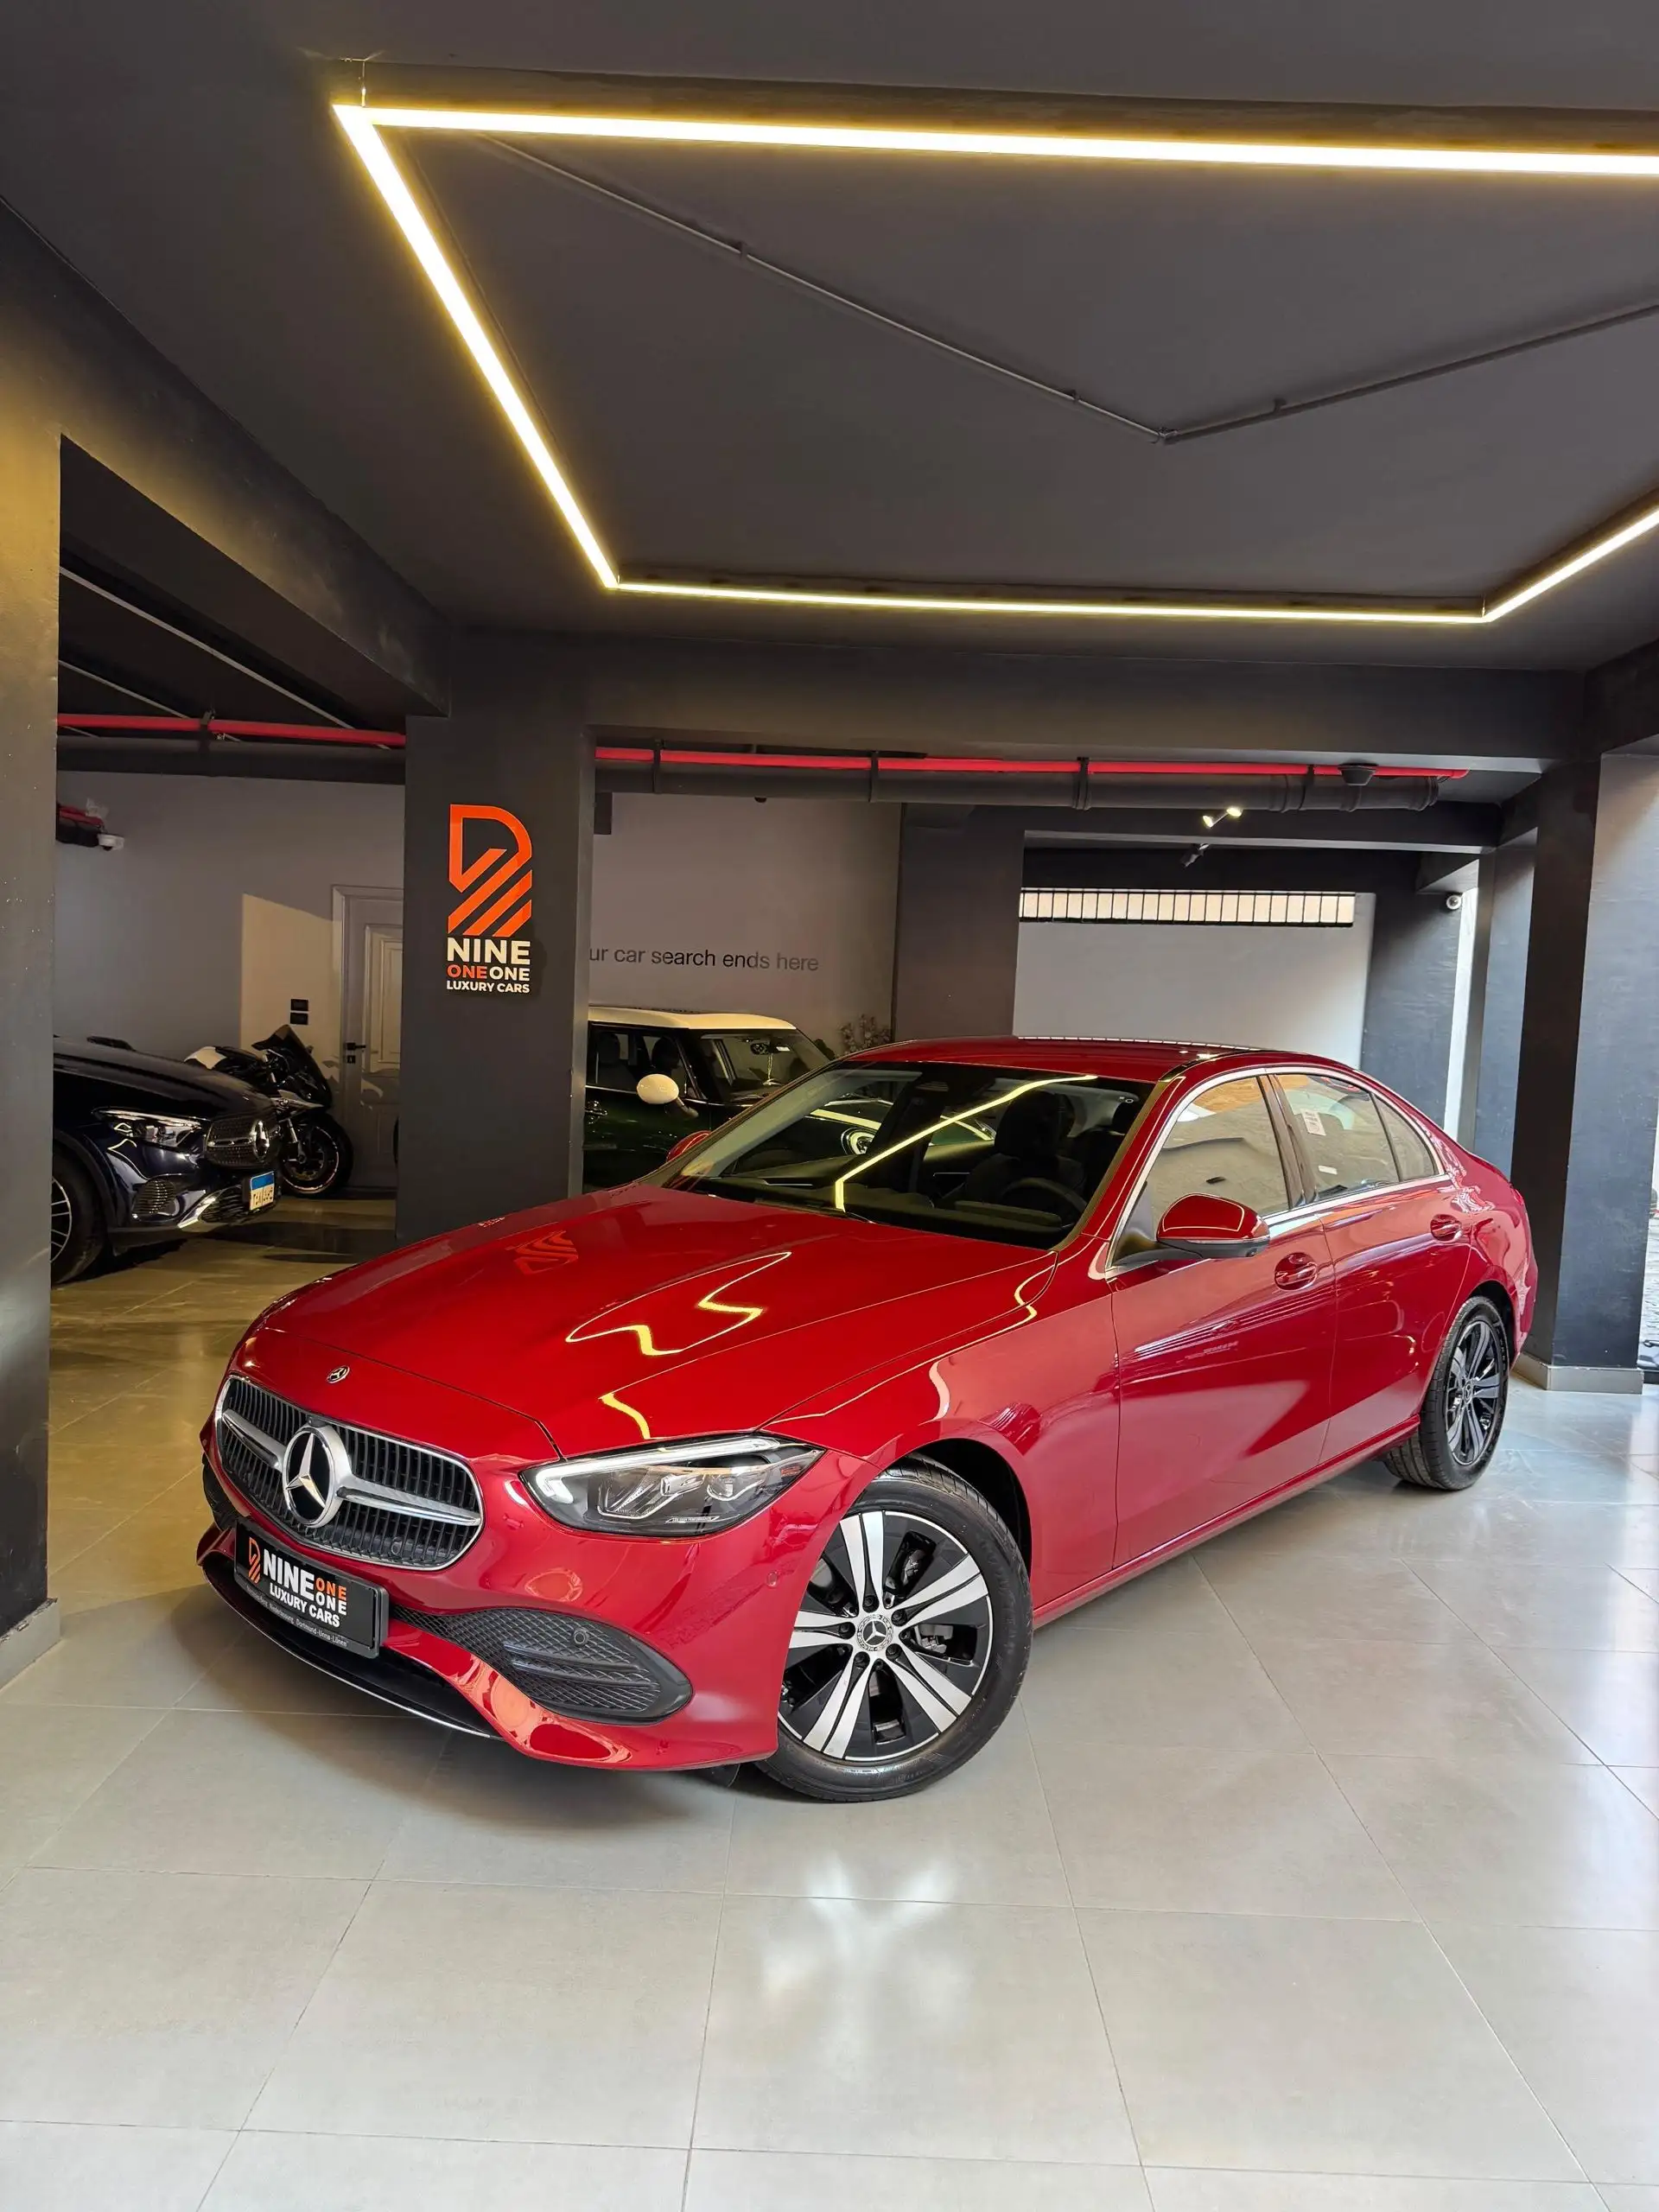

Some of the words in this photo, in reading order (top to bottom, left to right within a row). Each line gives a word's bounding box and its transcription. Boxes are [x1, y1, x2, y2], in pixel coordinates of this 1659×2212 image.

[448, 938, 531, 965] NINE
[614, 949, 645, 963] car
[652, 950, 715, 965] search
[723, 953, 770, 969] ends
[778, 953, 818, 970] here
[447, 965, 486, 978] ONE
[490, 967, 530, 982] ONE
[447, 981, 494, 992] LUXURY
[498, 983, 530, 993] CARS
[264, 1548, 315, 1601] NINE
[316, 1578, 346, 1599] ONE
[270, 1582, 306, 1612] LUXURY
[309, 1606, 340, 1627] CARS
[316, 1592, 346, 1616] ONE
